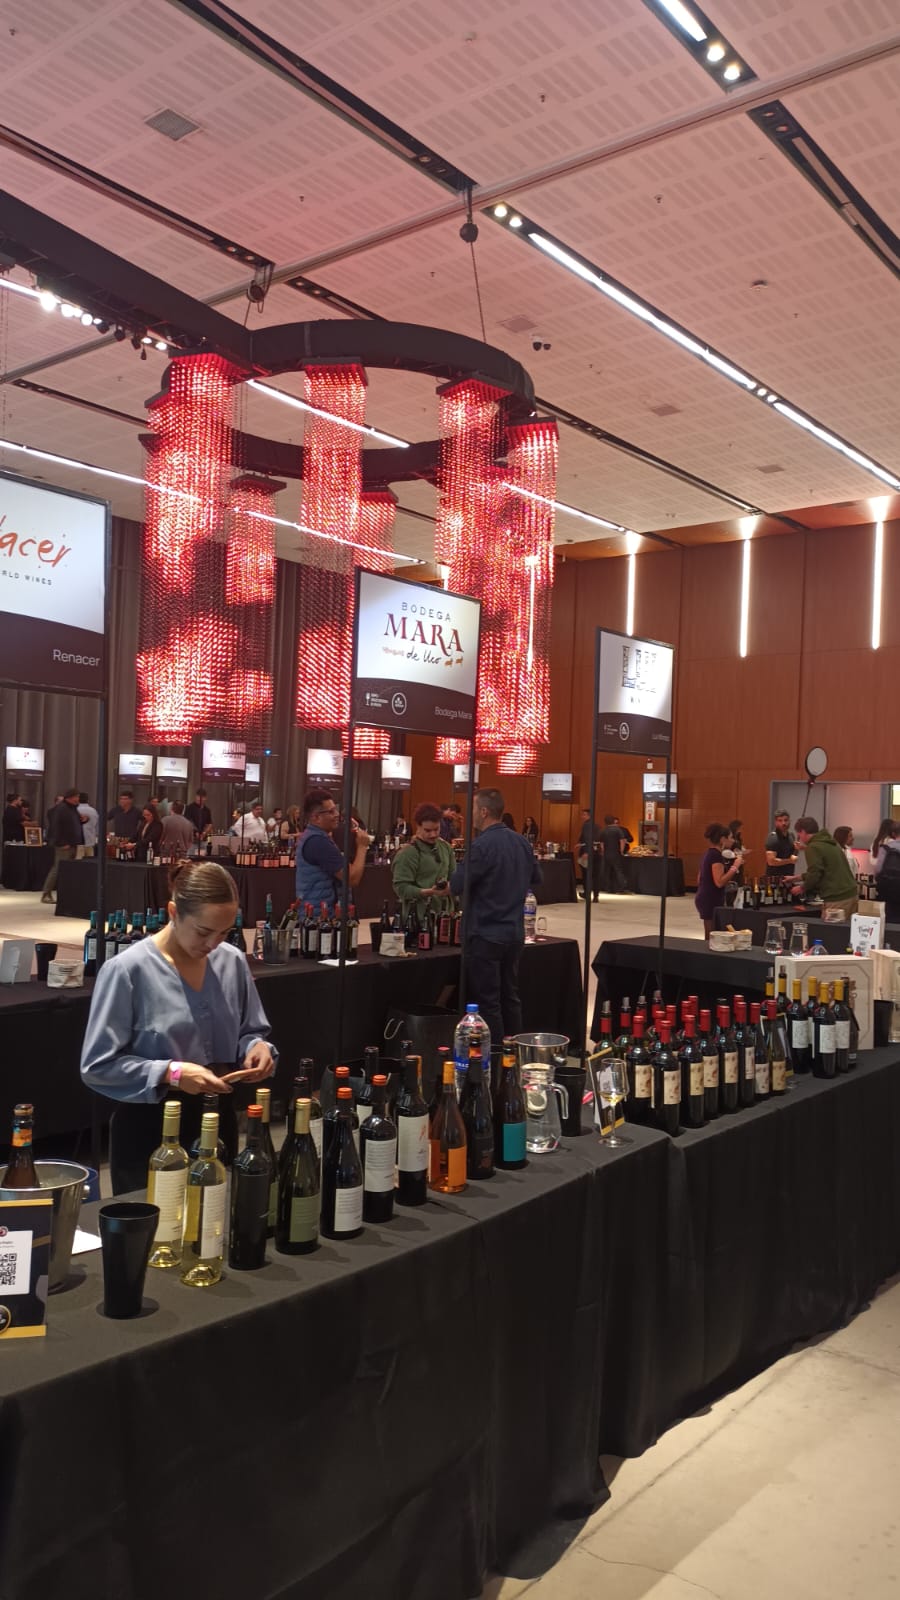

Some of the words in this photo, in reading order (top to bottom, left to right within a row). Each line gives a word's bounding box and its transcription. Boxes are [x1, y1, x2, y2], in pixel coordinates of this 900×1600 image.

[0, 517, 72, 568] acer
[0, 569, 20, 579] RLD
[24, 574, 53, 586] WINES
[401, 602, 451, 622] BODEGA
[384, 612, 464, 657] MARA
[53, 649, 100, 667] Renacer
[406, 645, 420, 662] de
[434, 706, 457, 719] Bodega
[458, 709, 472, 720] Mara
